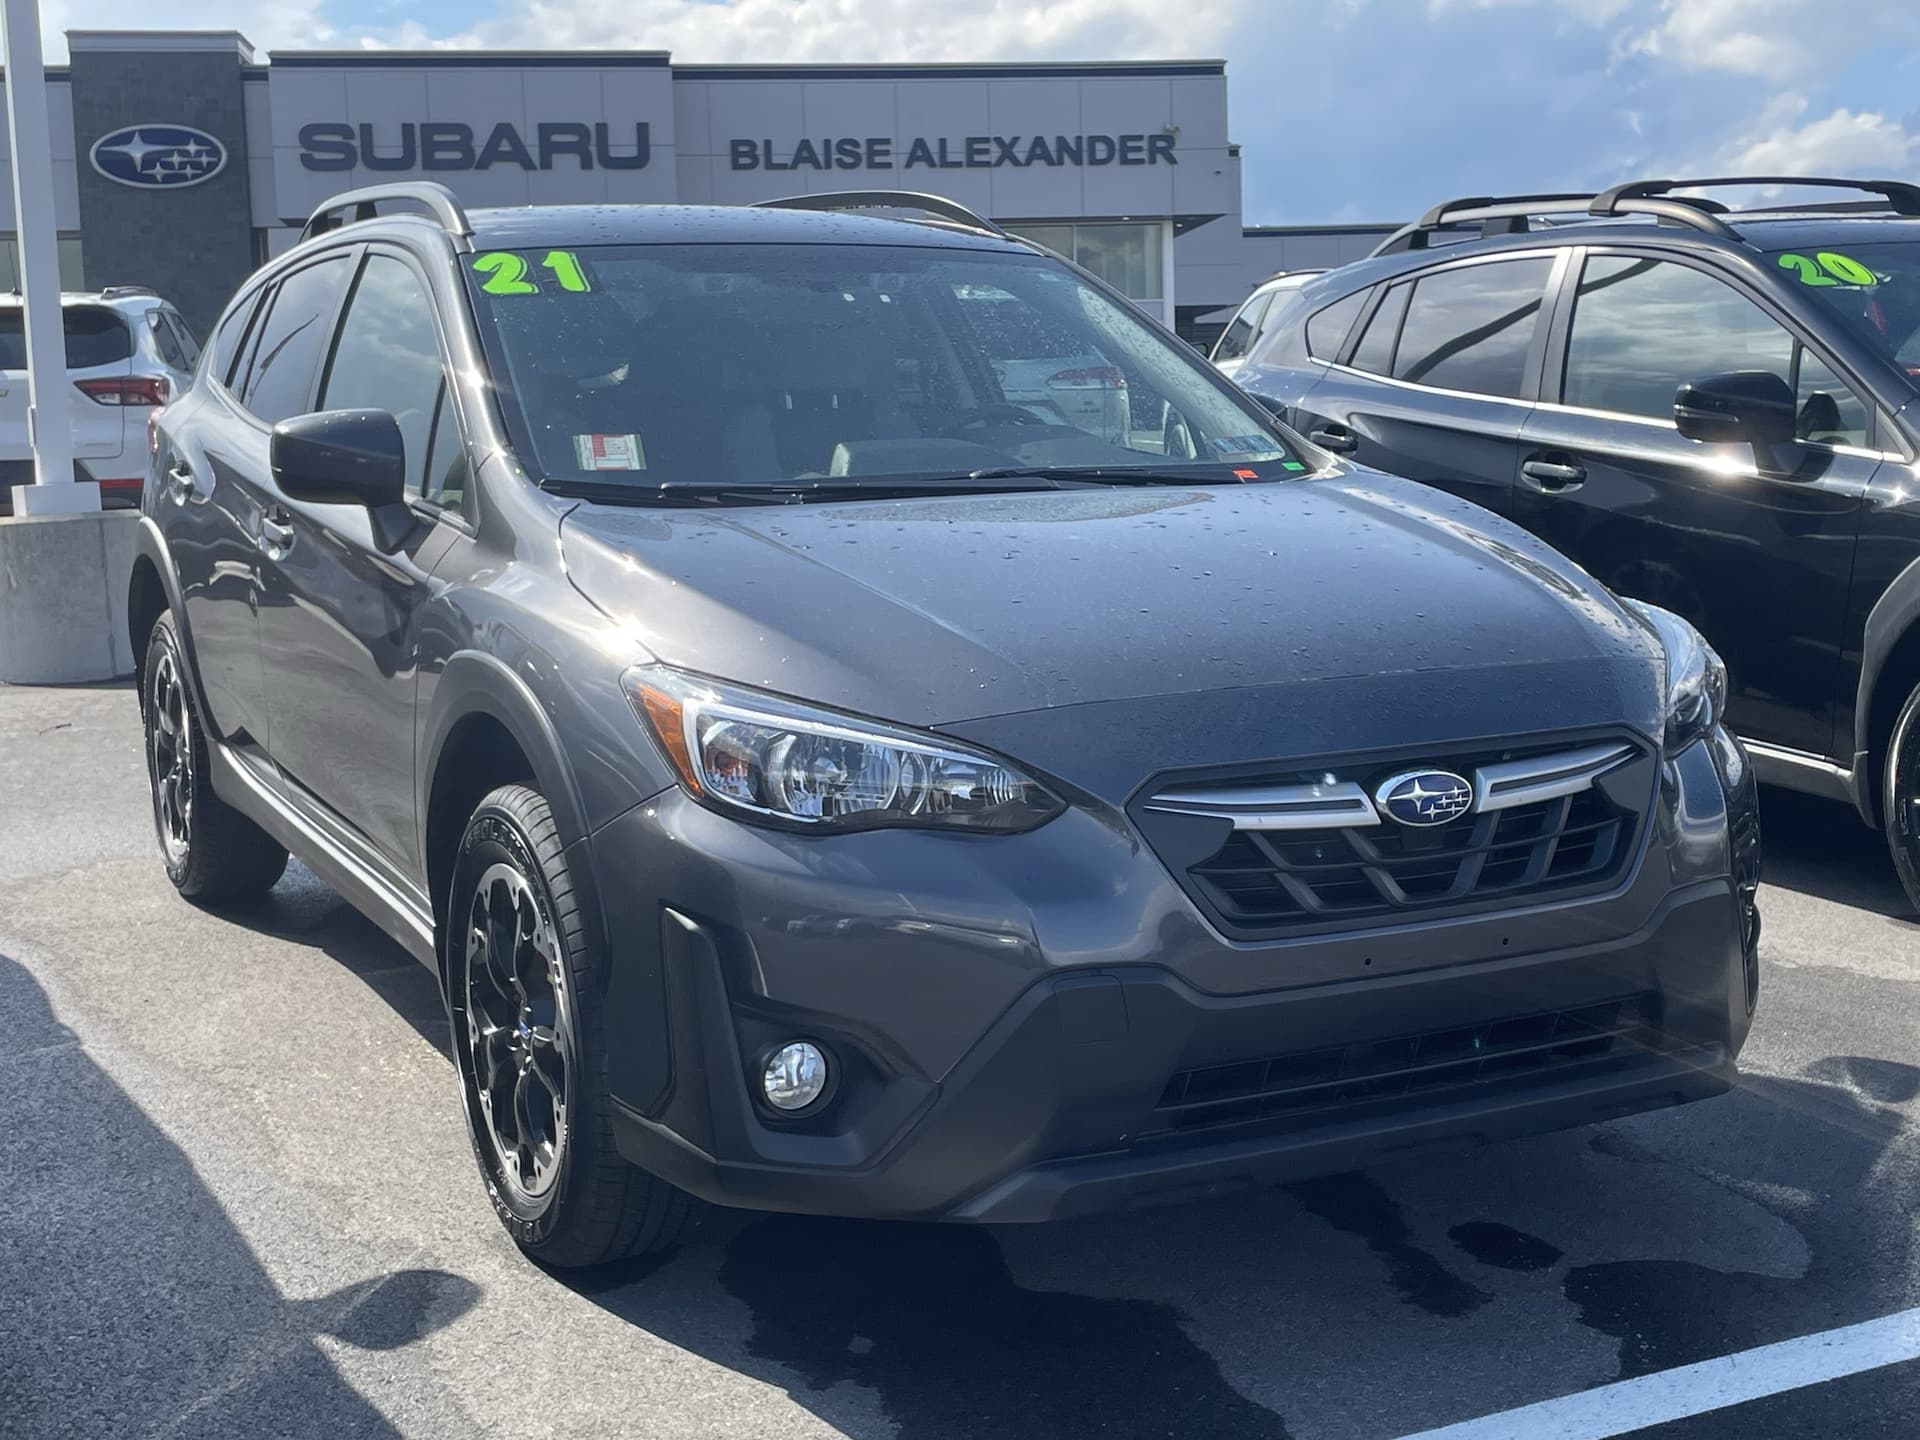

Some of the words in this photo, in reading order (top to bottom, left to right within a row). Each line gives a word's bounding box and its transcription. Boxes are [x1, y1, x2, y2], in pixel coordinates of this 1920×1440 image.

[299, 122, 651, 171] SUBARU
[730, 138, 893, 171] BLAISE
[905, 134, 1178, 169] ALEXANDER
[472, 250, 591, 294] 21
[1777, 250, 1878, 287] 20
